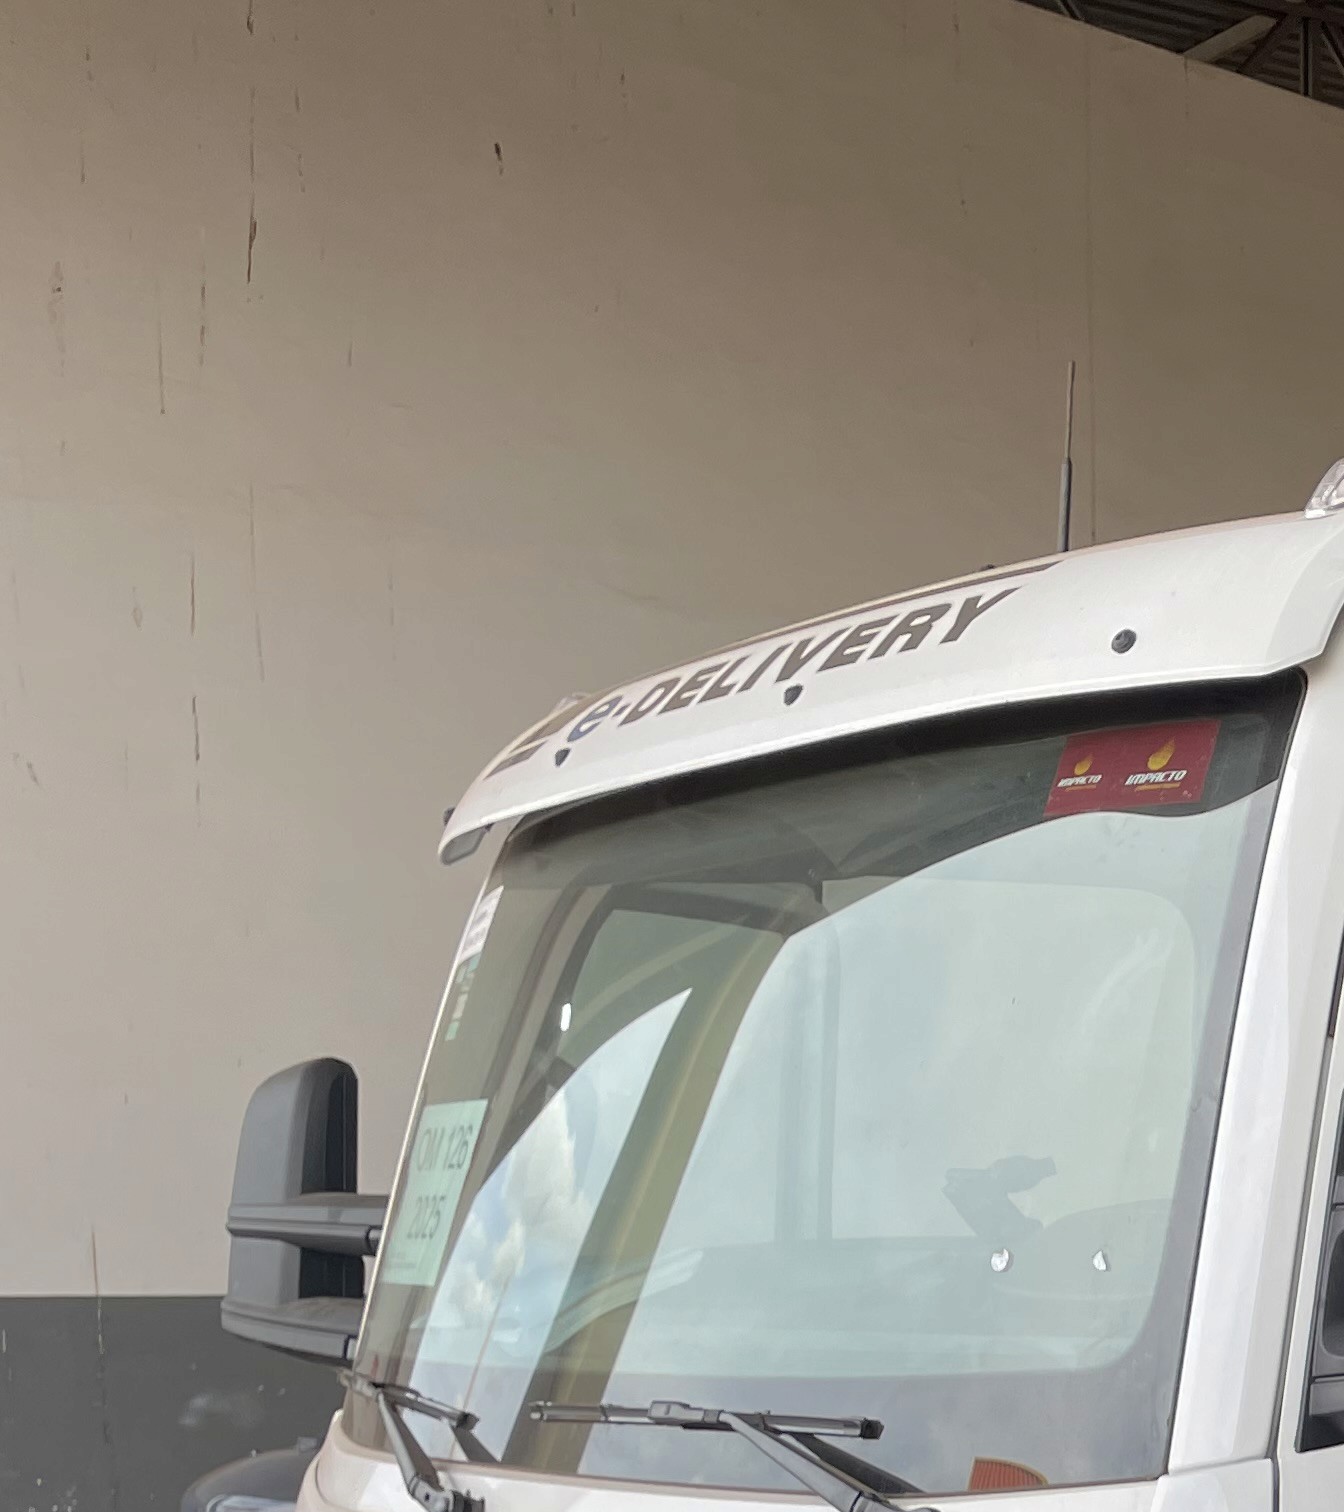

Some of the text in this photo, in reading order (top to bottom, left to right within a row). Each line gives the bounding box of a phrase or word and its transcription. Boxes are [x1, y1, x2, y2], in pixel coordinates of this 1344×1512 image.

[568, 586, 1022, 742] e-DELIVERY
[1057, 774, 1103, 788] IMPACTO
[1124, 769, 1188, 786] IMPACTO
[442, 1124, 474, 1171] 126
